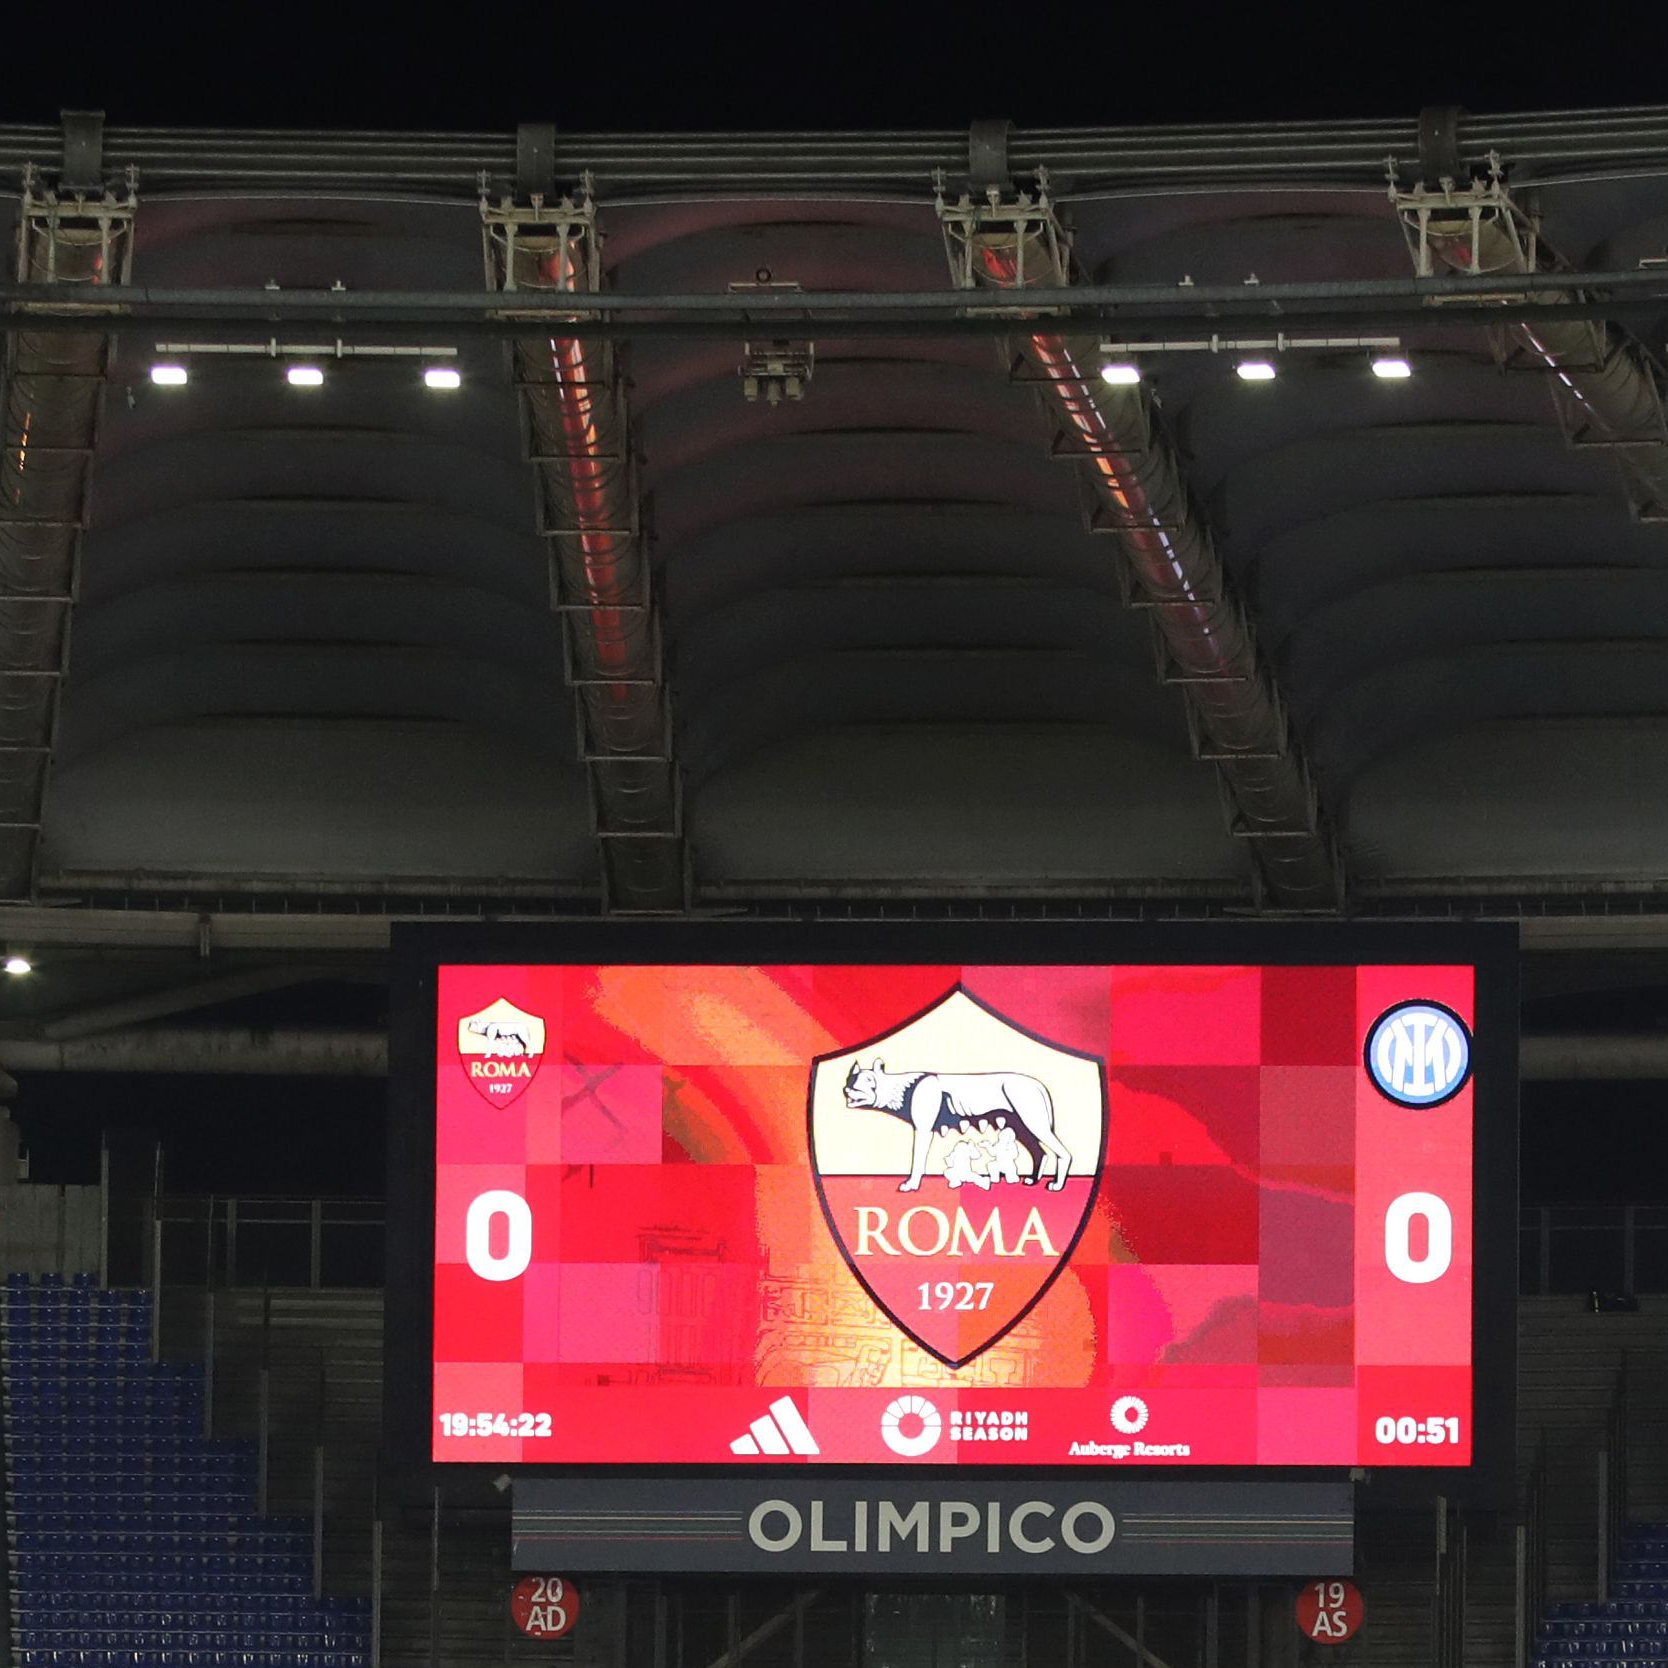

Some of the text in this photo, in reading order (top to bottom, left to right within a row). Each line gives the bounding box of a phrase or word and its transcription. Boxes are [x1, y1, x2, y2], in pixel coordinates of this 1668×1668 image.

[470, 1061, 532, 1078] ROMA
[488, 1083, 513, 1095] 1927
[466, 1190, 532, 1281] 0
[853, 1206, 1061, 1257] ROMA
[1385, 1192, 1452, 1283] 0
[917, 1282, 995, 1311] 1927
[439, 1412, 552, 1437] 19:54:22
[950, 1411, 1028, 1426] RIYADH
[1375, 1416, 1459, 1444] 00:51
[950, 1426, 1028, 1441] SEASON
[1068, 1441, 1191, 1459] Auberge Resorts
[748, 1499, 1116, 1554] OLIMPICO
[531, 1577, 564, 1603] 20
[1314, 1582, 1346, 1608] 19
[526, 1606, 567, 1632] AD
[1311, 1611, 1349, 1637] AS
